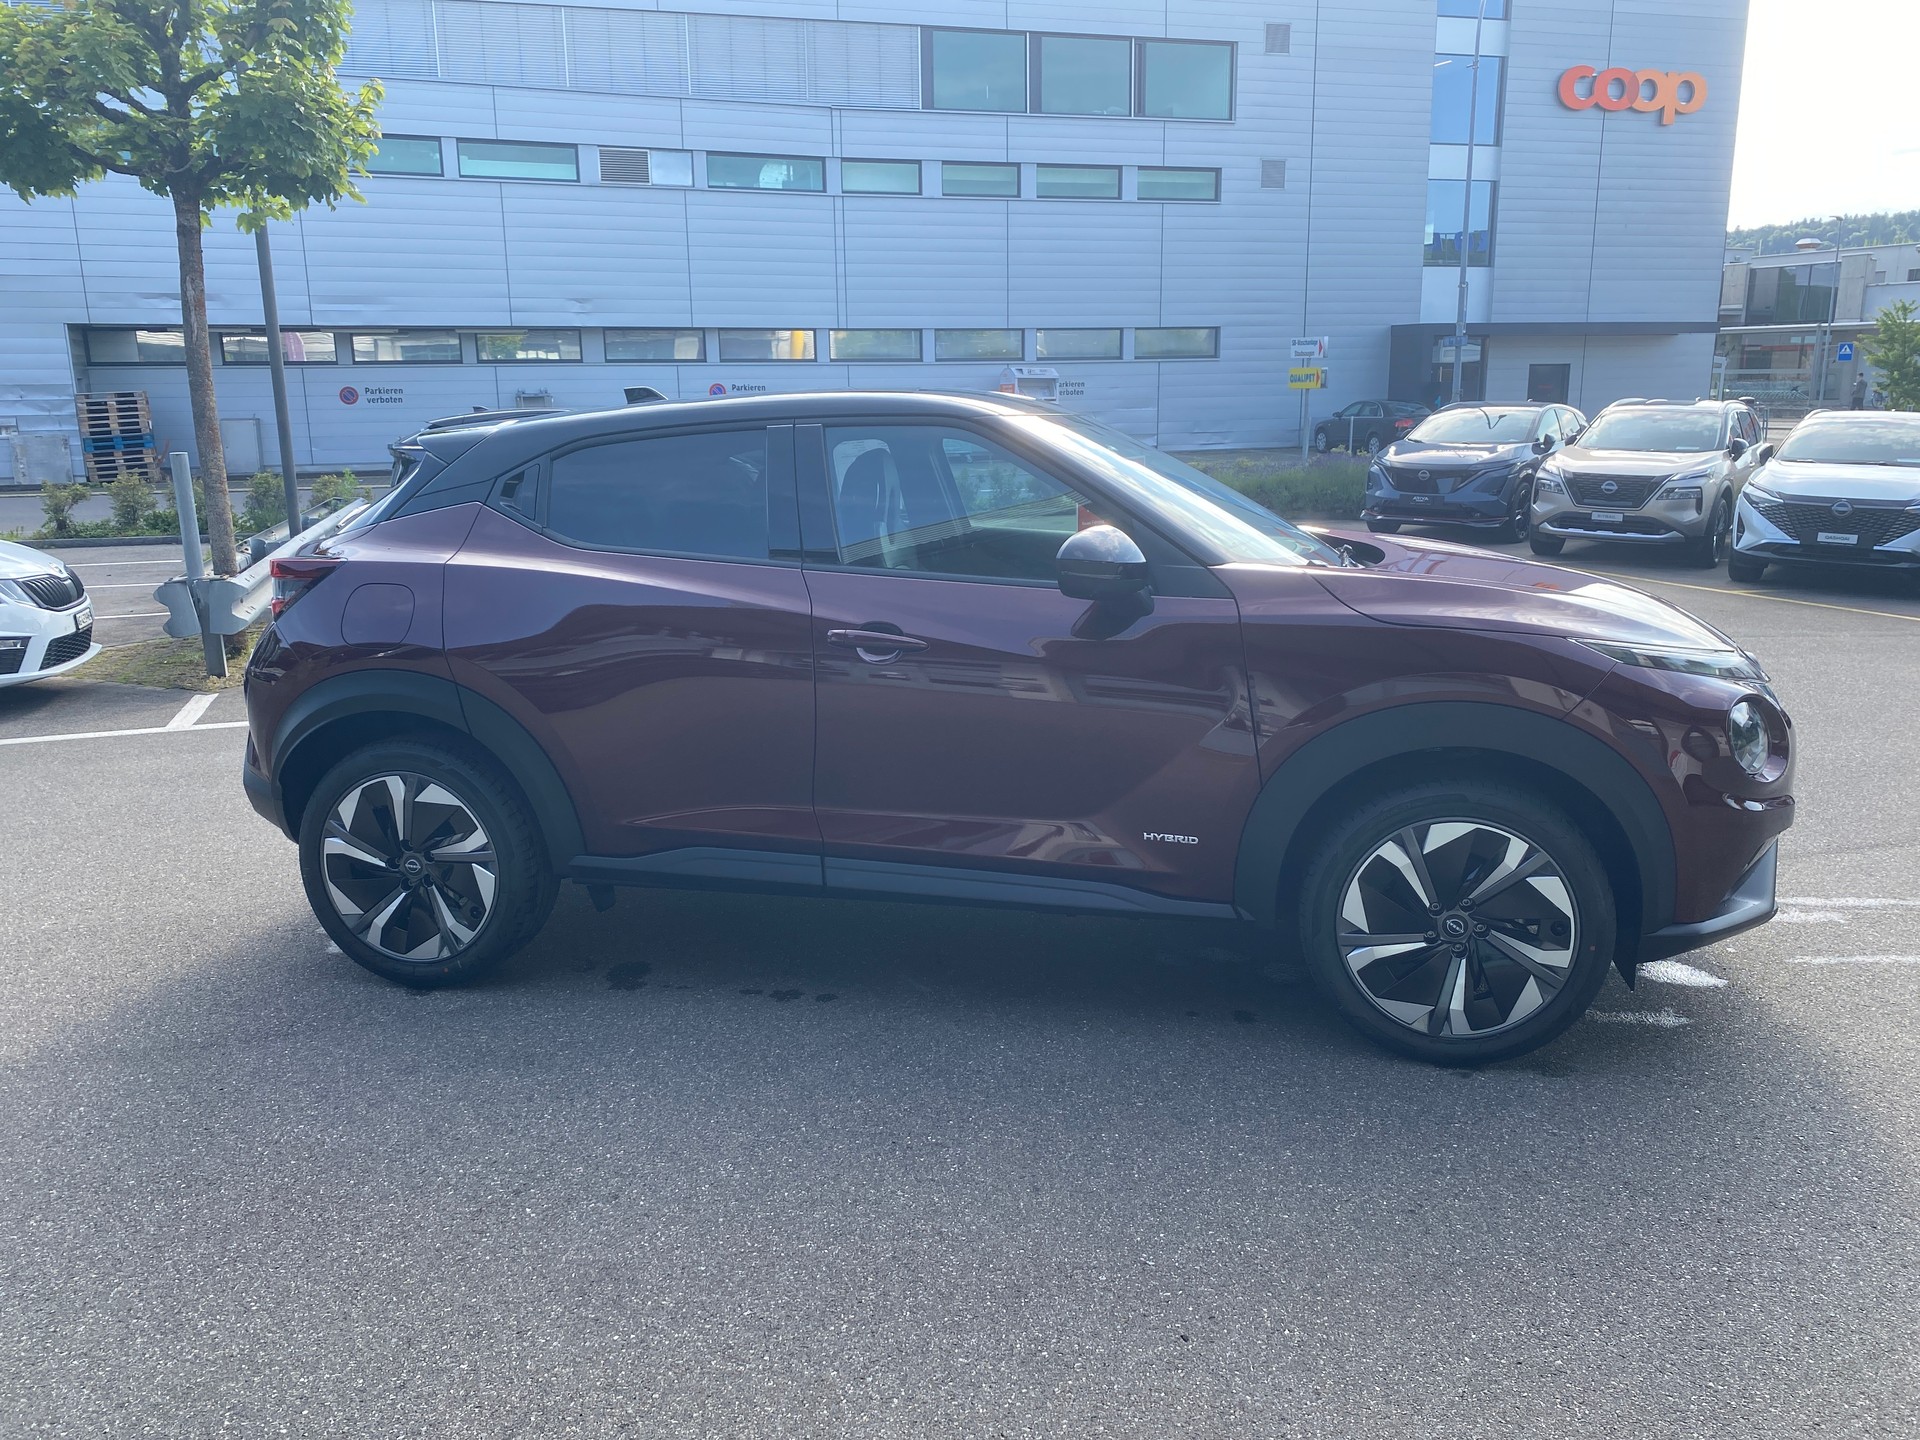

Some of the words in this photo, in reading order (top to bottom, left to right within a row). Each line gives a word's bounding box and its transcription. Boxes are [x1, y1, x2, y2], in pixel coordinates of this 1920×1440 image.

[1558, 64, 1708, 126] coop
[1290, 373, 1315, 383] QUALIPET
[364, 387, 404, 395] Parkieren
[731, 383, 766, 392] Parkieren
[366, 396, 403, 404] verboten
[1143, 832, 1199, 844] HYBRID
